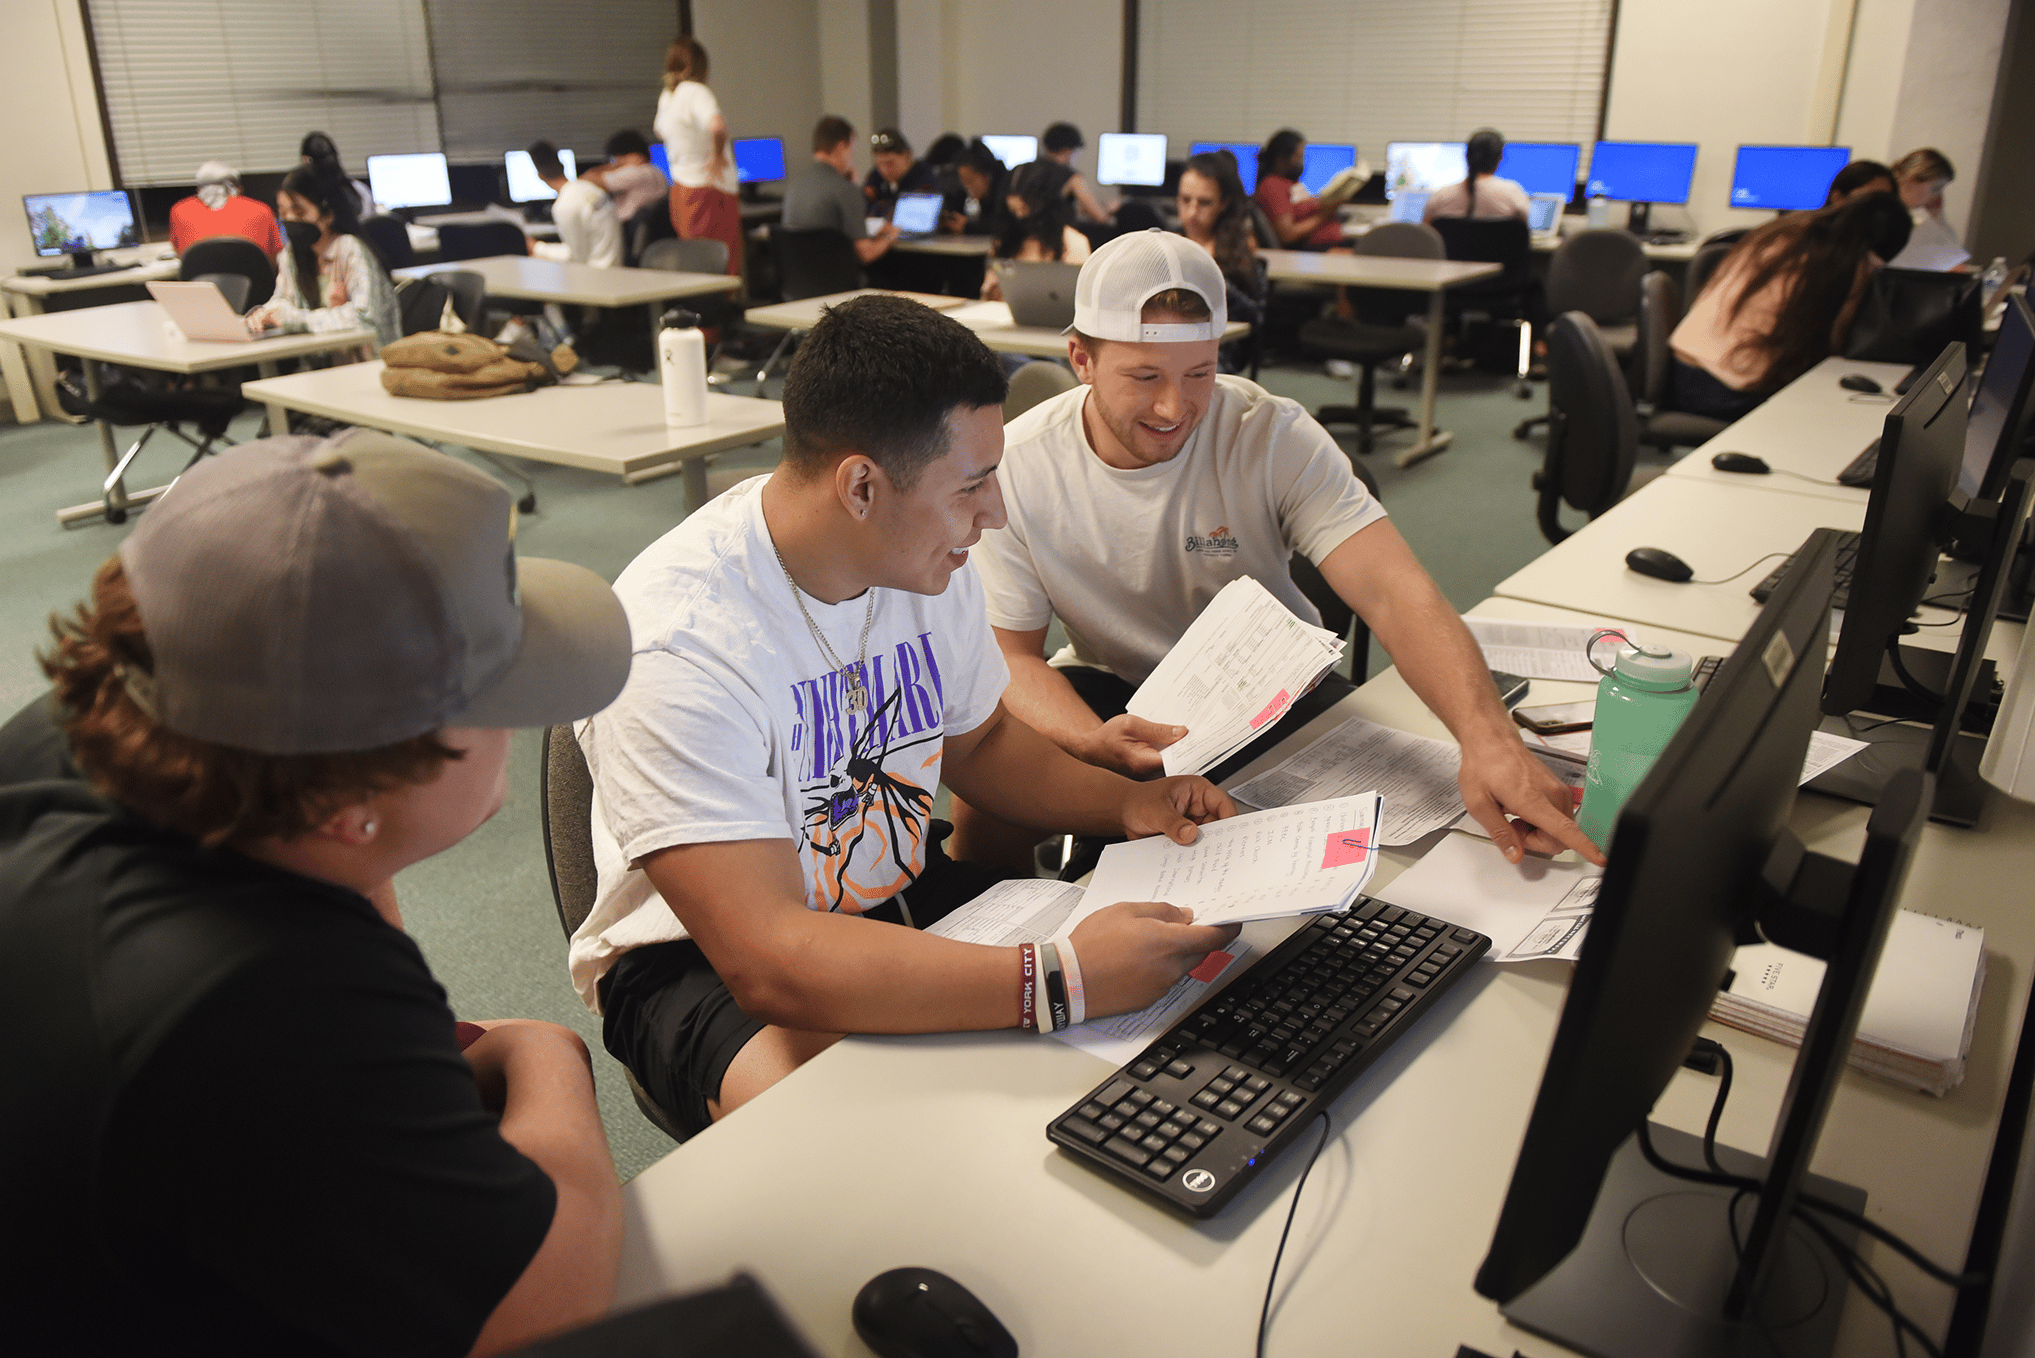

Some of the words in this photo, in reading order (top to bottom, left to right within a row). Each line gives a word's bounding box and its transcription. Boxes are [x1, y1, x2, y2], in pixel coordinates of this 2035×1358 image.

[846, 686, 868, 715] 30
[1024, 948, 1032, 976] CITY
[1773, 962, 1783, 975] FIVE
[1024, 981, 1032, 1014] YORK
